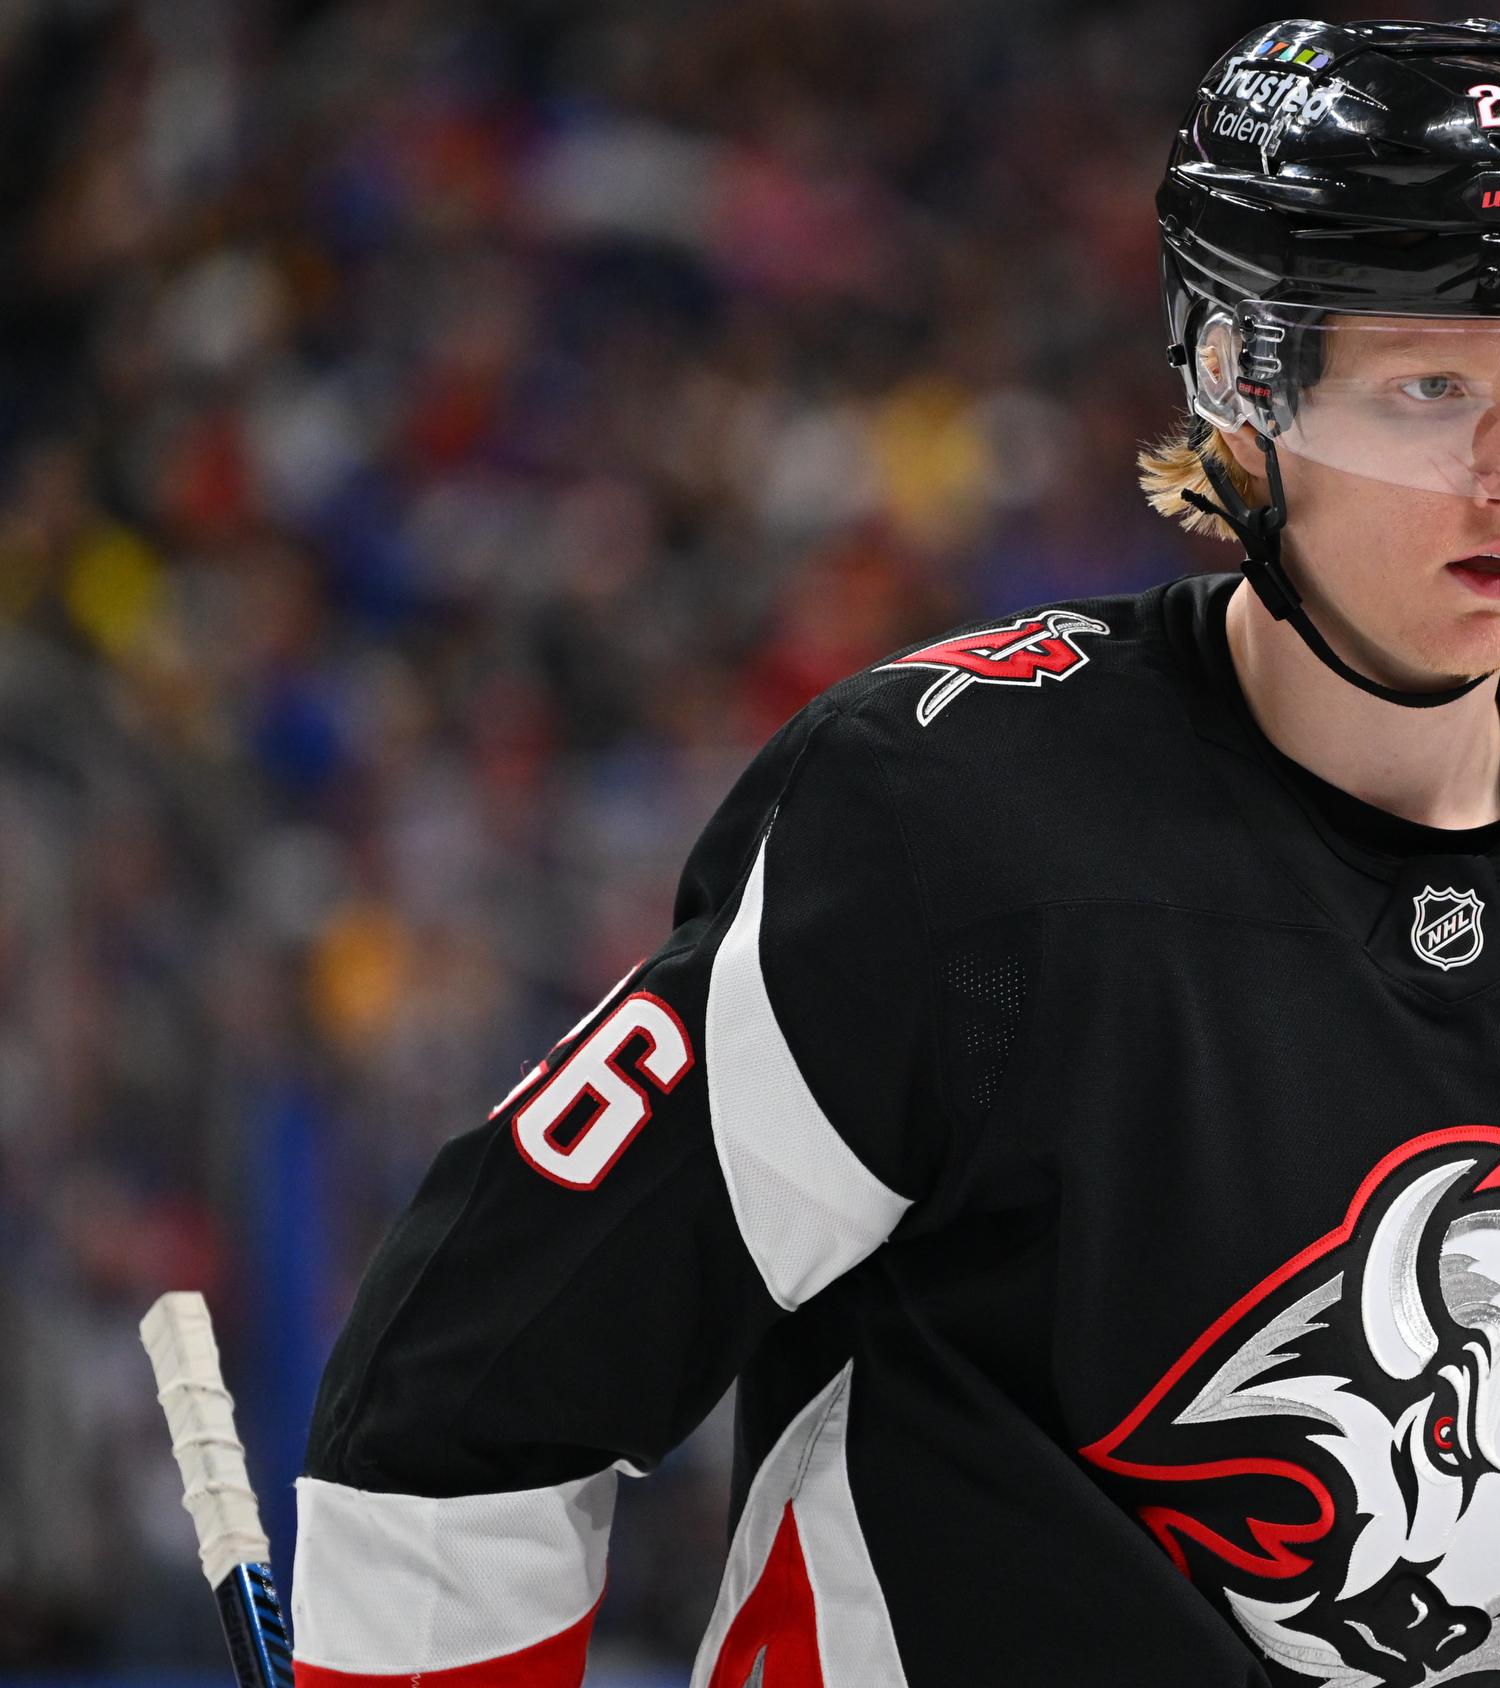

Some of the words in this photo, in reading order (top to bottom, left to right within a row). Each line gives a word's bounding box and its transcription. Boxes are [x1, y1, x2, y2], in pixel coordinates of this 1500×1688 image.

[1215, 56, 1345, 121] Trusted
[1212, 105, 1281, 151] talent
[1427, 910, 1470, 950] NHL
[488, 958, 696, 1192] 6
